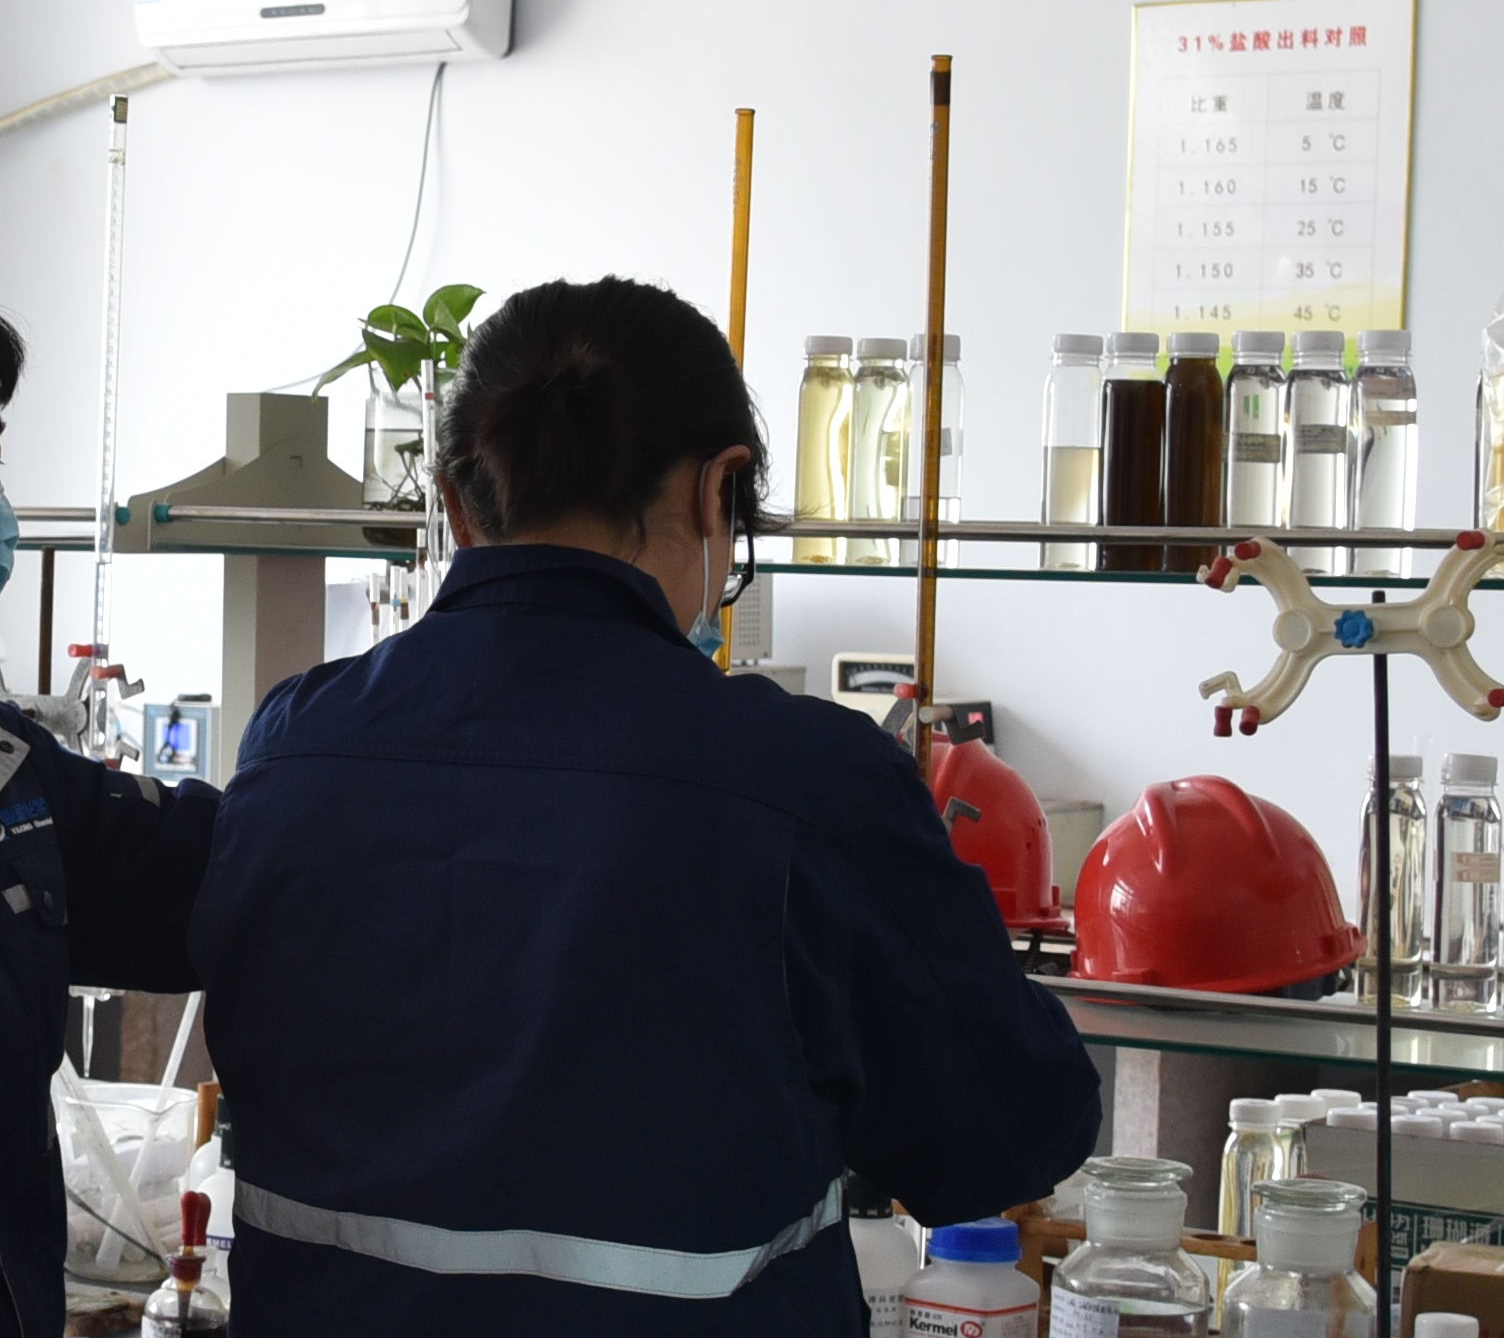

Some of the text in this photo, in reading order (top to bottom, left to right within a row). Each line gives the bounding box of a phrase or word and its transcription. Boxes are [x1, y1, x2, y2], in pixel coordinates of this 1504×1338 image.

[1177, 25, 1368, 53] 31%盐酸出料对照
[1190, 90, 1346, 114] 比重 温度
[1180, 136, 1238, 154] 1.165
[1178, 179, 1237, 196] 1.160
[1177, 221, 1235, 237] 1.155
[1175, 263, 1234, 280] 1.150
[1173, 304, 1232, 321] 1.145
[908, 1316, 958, 1337] Kermel
